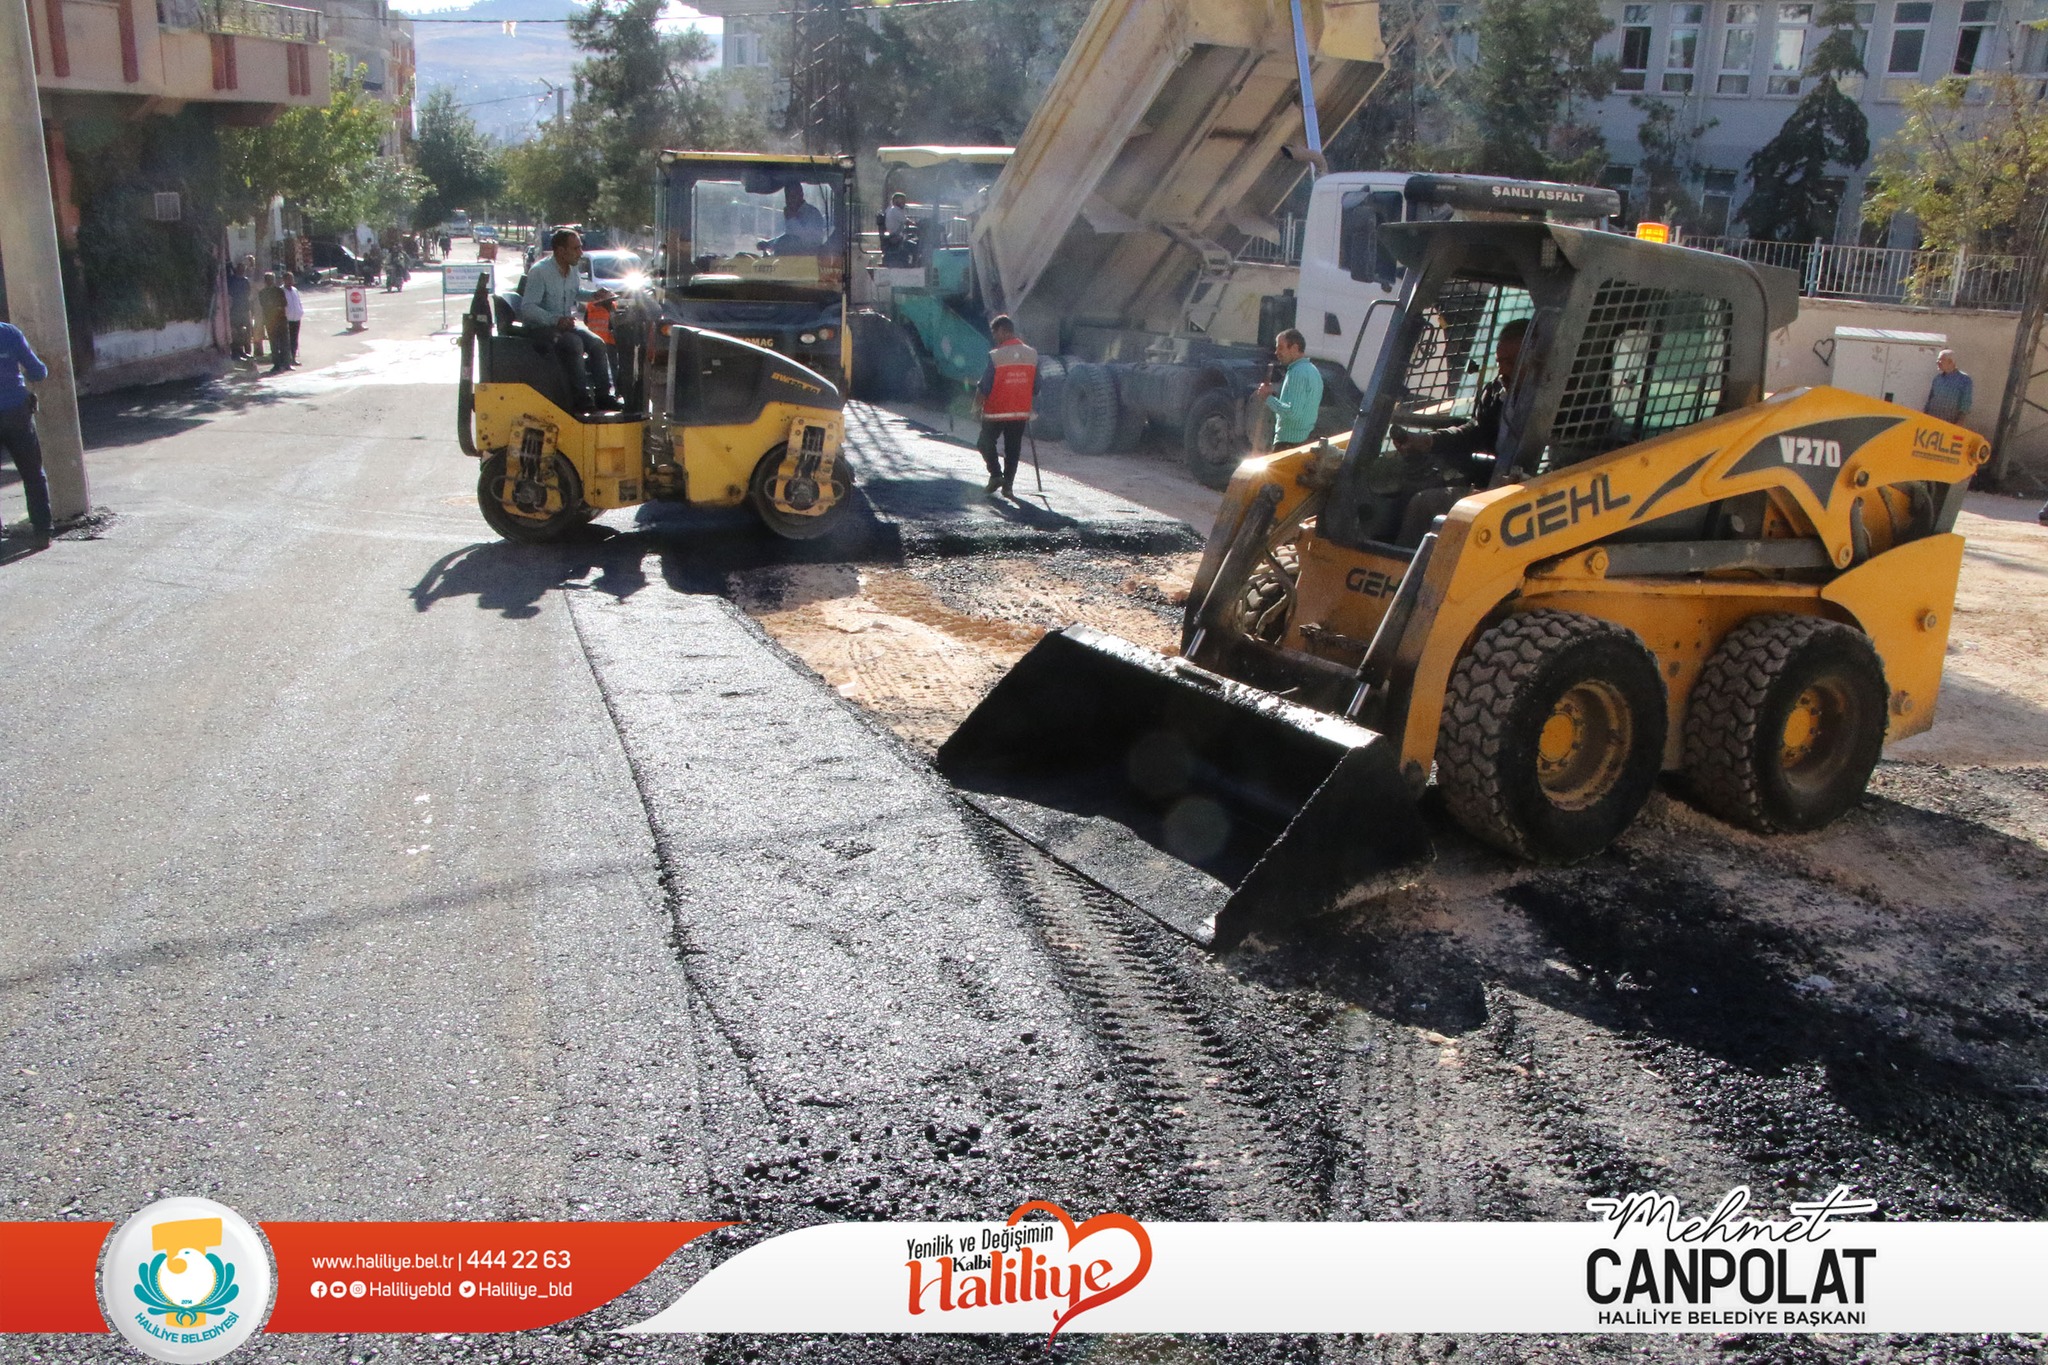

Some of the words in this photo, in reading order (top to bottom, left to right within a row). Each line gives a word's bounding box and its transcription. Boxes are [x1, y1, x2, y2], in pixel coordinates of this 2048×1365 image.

[1492, 185, 1534, 199] ŞANLI
[1537, 189, 1585, 203] ASFALT
[741, 337, 774, 348] OMAG
[1779, 435, 1841, 468] V270
[1913, 427, 1964, 456] KALE
[1500, 473, 1631, 547] GEHL
[1345, 566, 1403, 599] GEH
